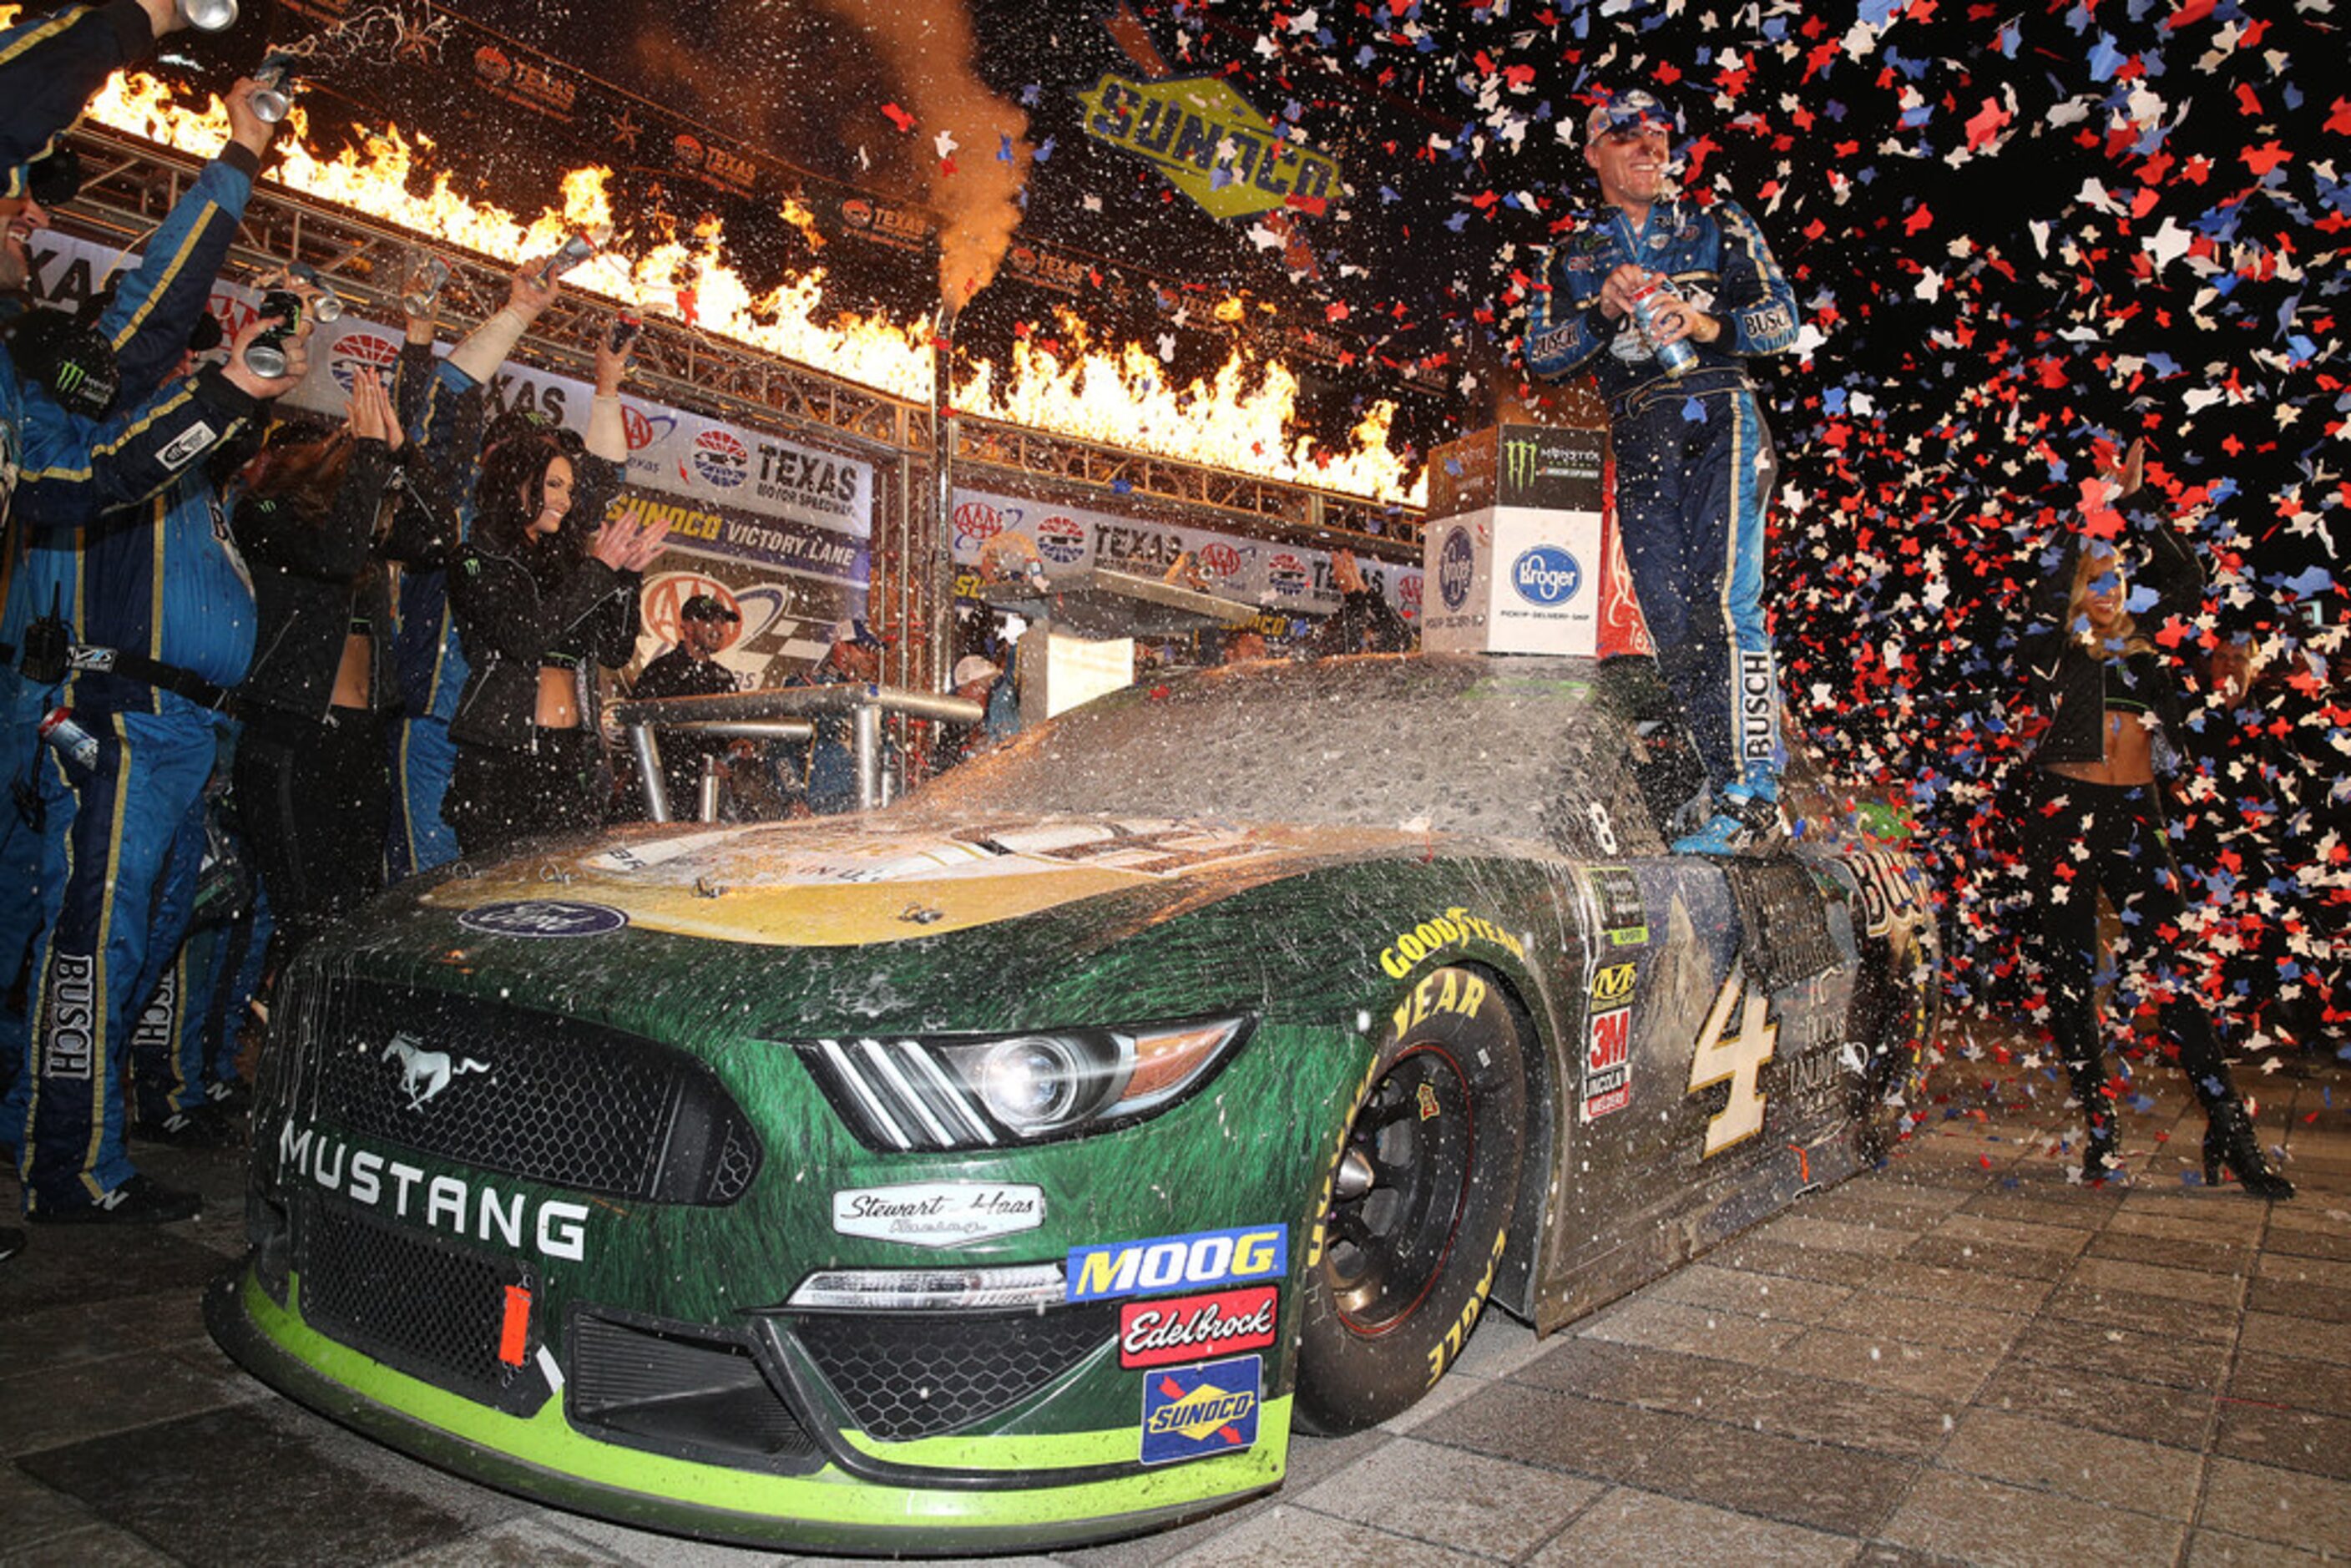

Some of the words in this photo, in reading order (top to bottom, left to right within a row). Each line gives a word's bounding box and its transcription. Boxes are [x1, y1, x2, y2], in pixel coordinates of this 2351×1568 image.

[1092, 83, 1333, 197] SUNOCO
[486, 372, 566, 425] XAS
[627, 456, 660, 474] exas
[758, 443, 857, 501] TEXAS
[727, 521, 803, 556] VICTORY
[808, 539, 856, 567] LANE
[1095, 524, 1182, 565] TEXAS
[1519, 554, 1575, 599] Kroger
[1744, 653, 1773, 758] BUSCH
[1379, 907, 1524, 979] GOODYEAR
[48, 954, 92, 1077] BUSCH
[1590, 1010, 1629, 1069] 3M
[1687, 954, 1779, 1159] 4
[280, 1120, 589, 1262] MUSTANG
[1076, 1231, 1279, 1295] MOOG
[1124, 1298, 1274, 1353] Edelbrock
[1152, 1393, 1252, 1431] SUNOCO
